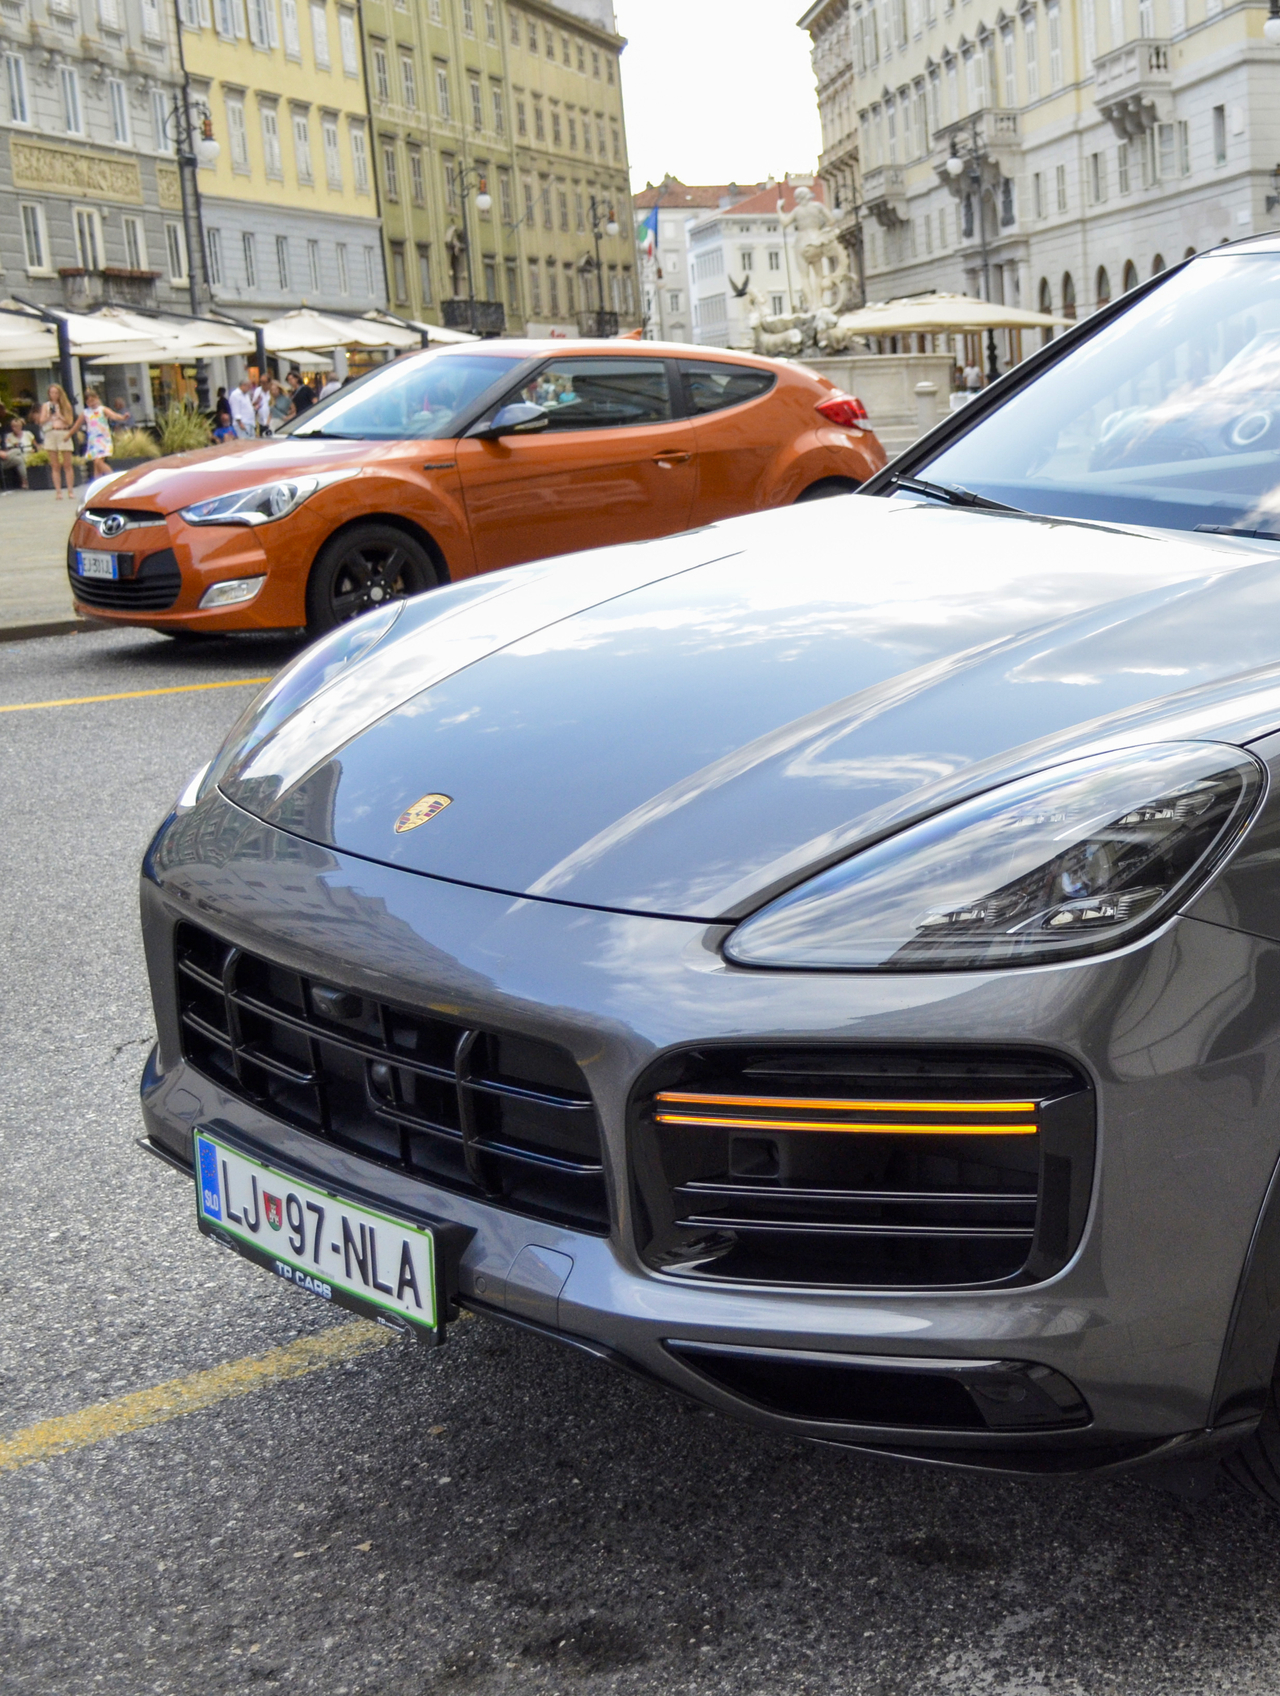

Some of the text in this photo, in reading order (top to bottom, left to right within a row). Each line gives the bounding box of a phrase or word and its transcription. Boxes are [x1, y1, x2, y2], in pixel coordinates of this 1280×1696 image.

[204, 1188, 219, 1212] SLO
[222, 1160, 423, 1309] LJ 97-NLA
[276, 1261, 292, 1279] TP
[295, 1271, 332, 1300] CARS
